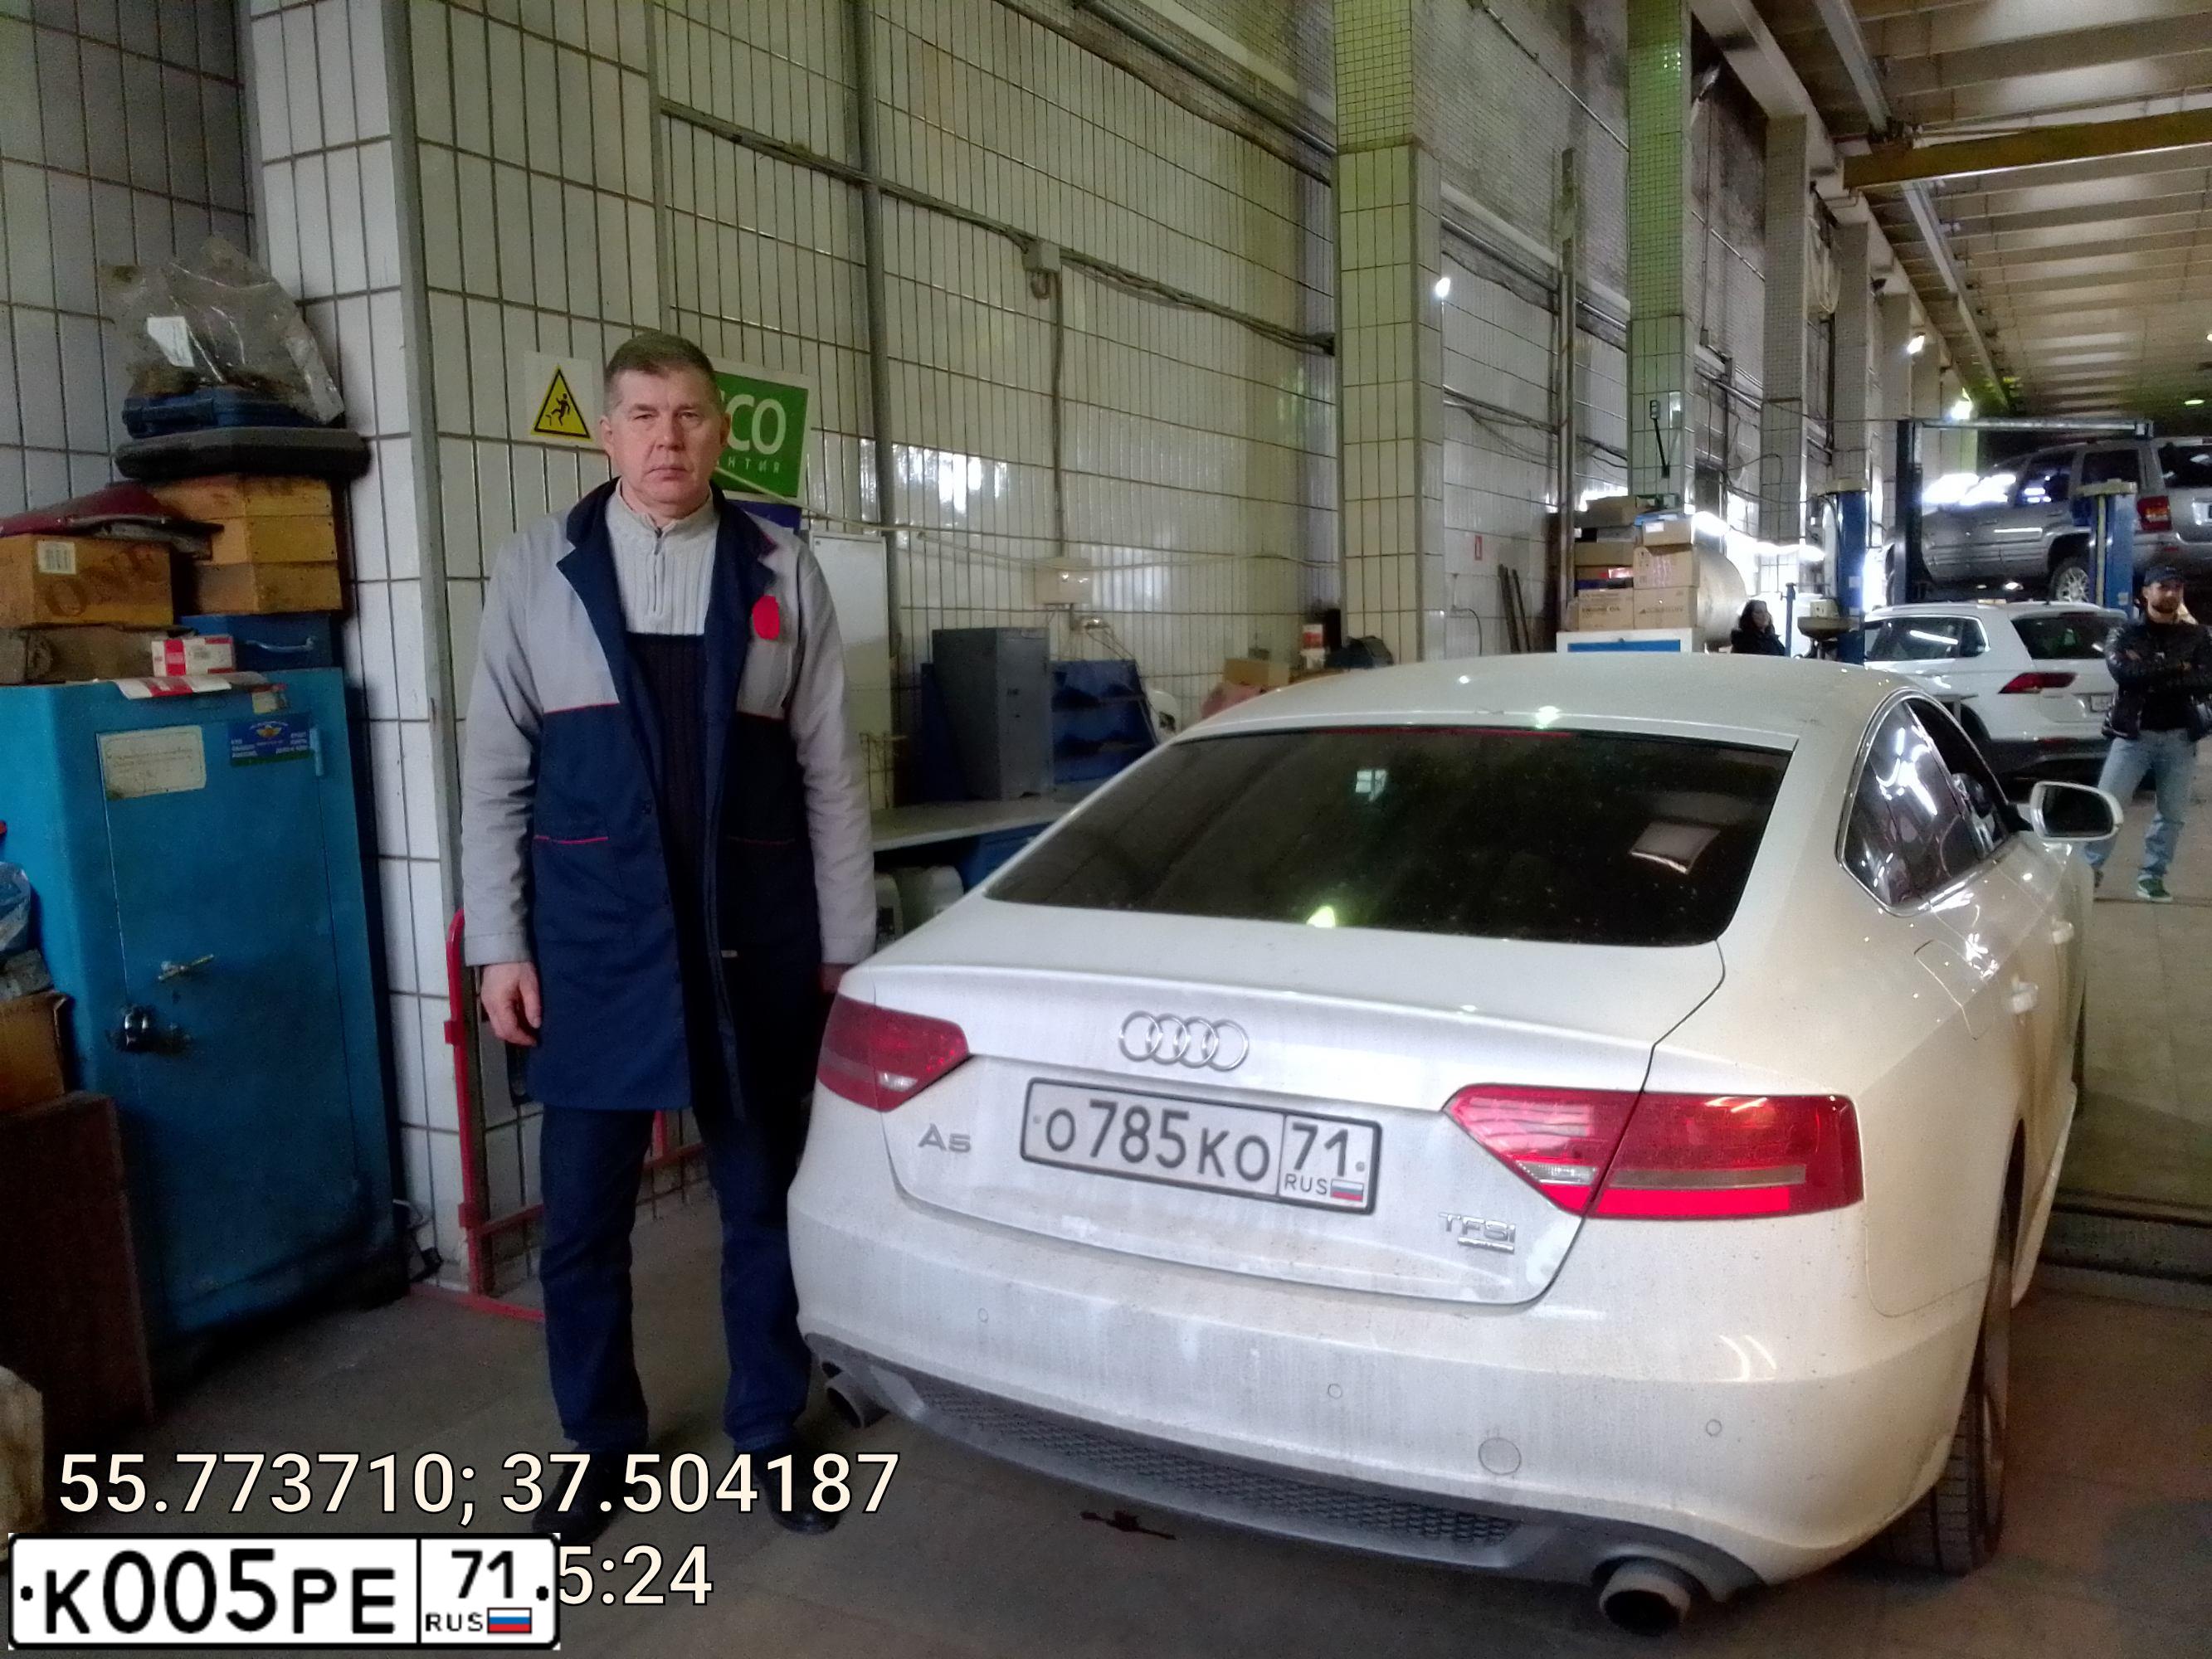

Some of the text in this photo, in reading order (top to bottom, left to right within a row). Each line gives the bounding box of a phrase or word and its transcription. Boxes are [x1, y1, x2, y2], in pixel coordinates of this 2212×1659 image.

[720, 391, 787, 455] СО
[717, 456, 781, 474] НТИЯ
[918, 1123, 971, 1153] A5
[1045, 1098, 1350, 1182] О785КО 71
[1284, 1174, 1328, 1195] RUS
[1440, 1213, 1516, 1243] TFSI
